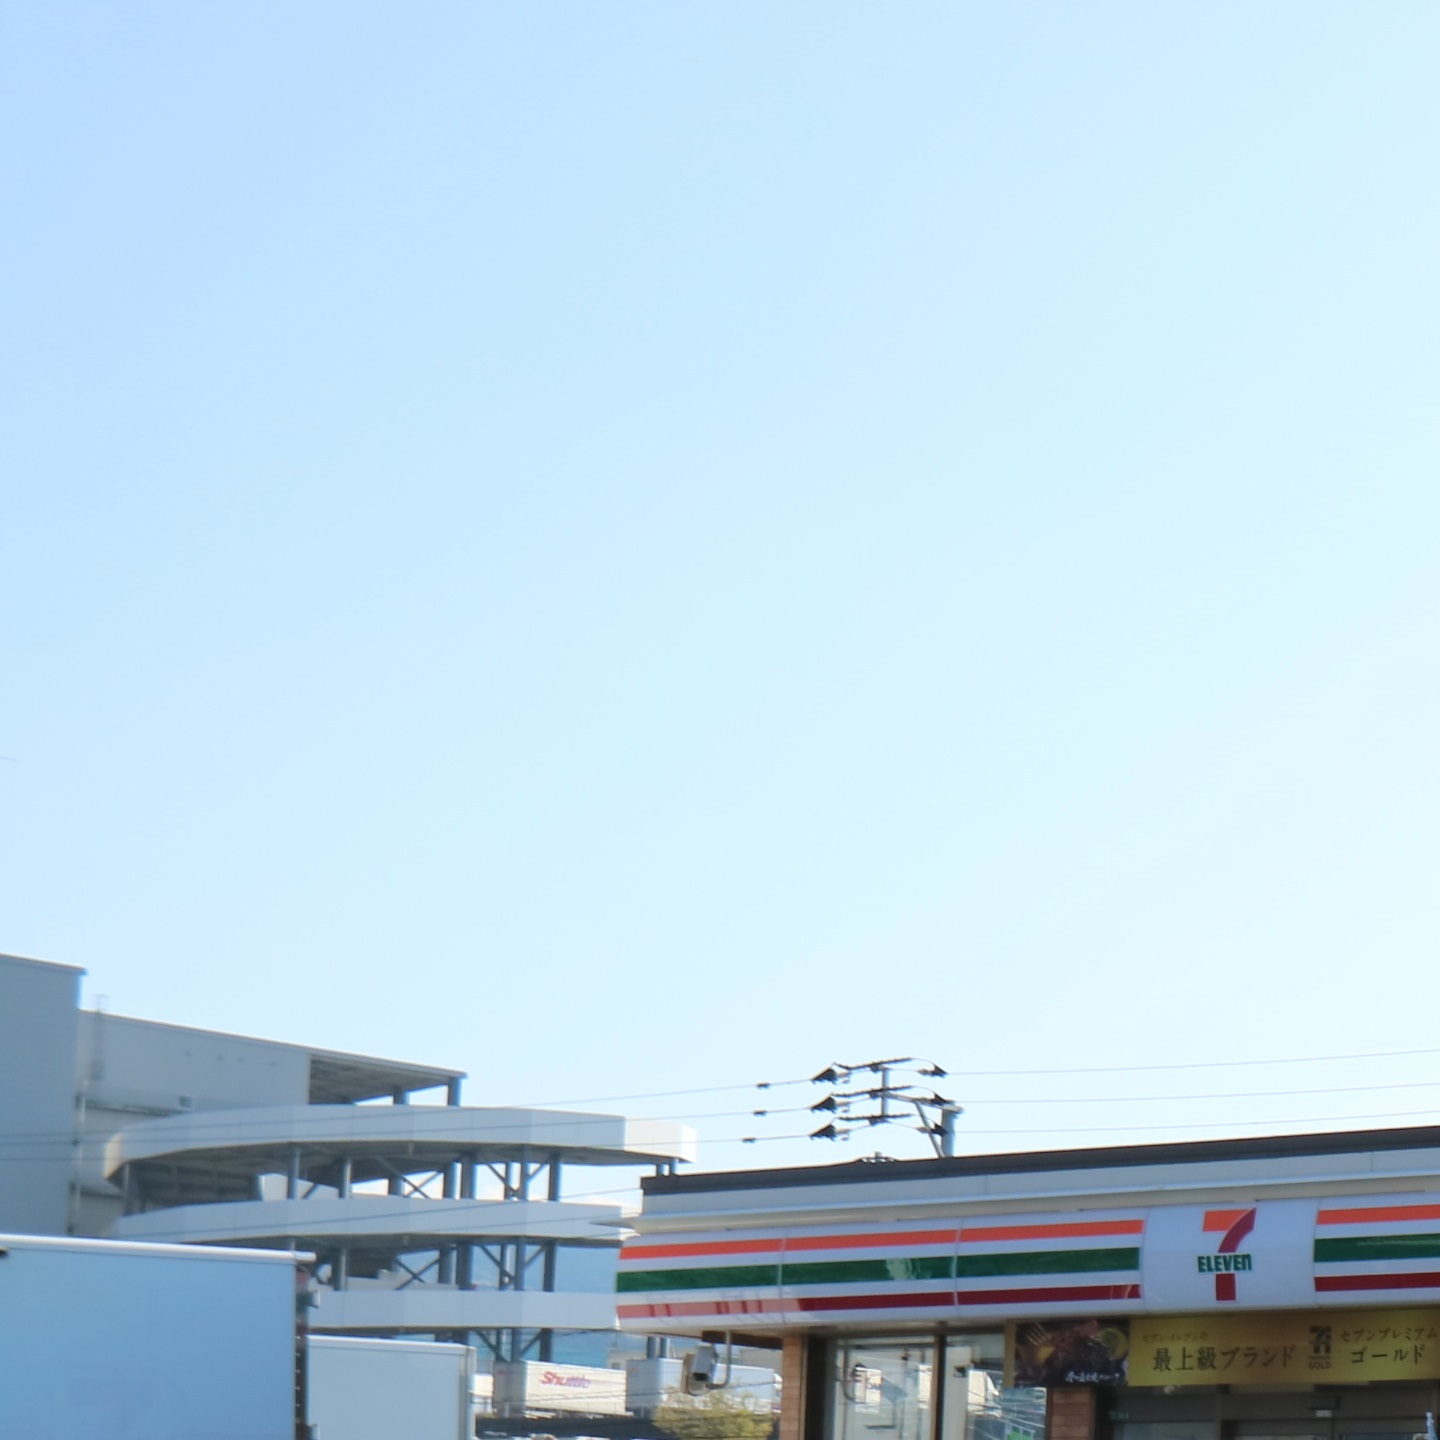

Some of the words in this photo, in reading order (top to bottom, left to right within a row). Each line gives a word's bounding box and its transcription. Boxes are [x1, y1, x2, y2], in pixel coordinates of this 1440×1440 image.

[1340, 1327, 1438, 1343] セブンプレミアム
[1152, 1345, 1296, 1372] 最上級ブランド
[1351, 1344, 1425, 1364] ゴールド
[1308, 1361, 1332, 1370] GOLD
